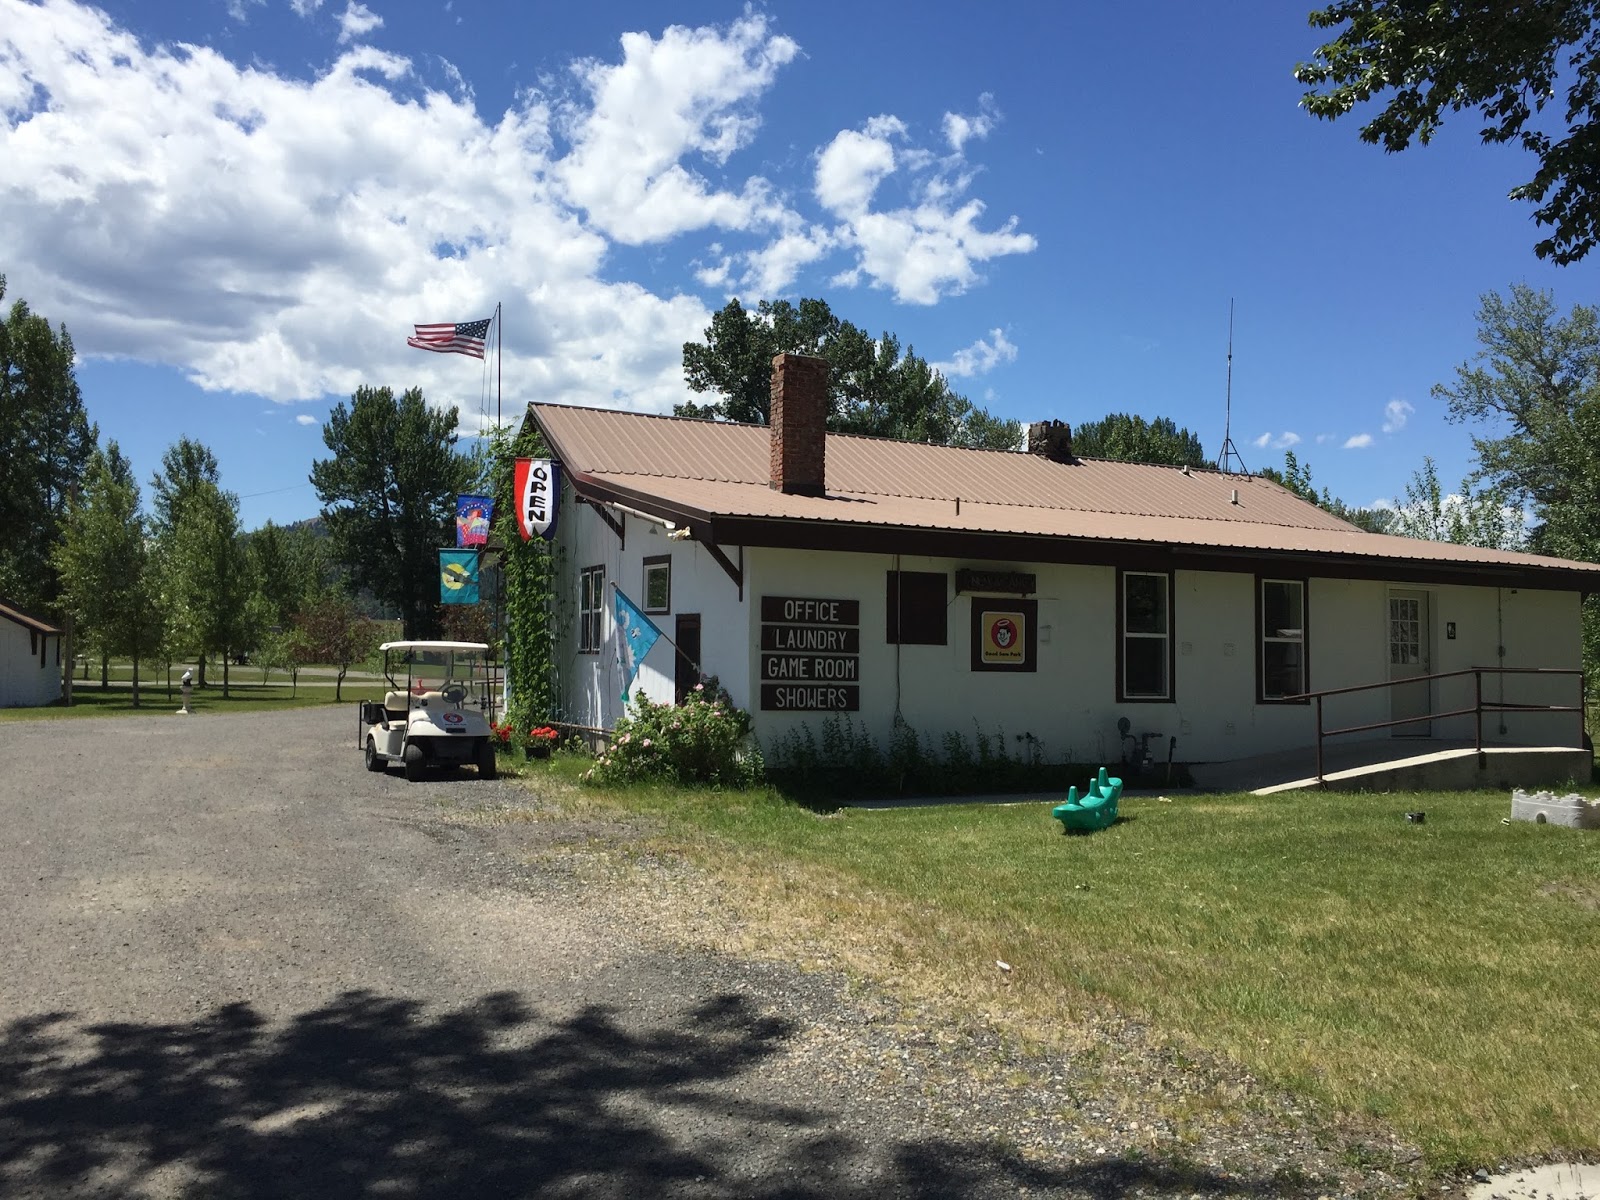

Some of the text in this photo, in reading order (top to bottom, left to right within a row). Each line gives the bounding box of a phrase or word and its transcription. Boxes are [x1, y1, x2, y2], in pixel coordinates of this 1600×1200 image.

[528, 467, 548, 522] OPEN
[784, 600, 840, 621] OFFICE
[775, 628, 847, 650] LAUNDRY
[768, 657, 855, 679] GAME ROOM
[775, 687, 847, 708] SHOWERS
